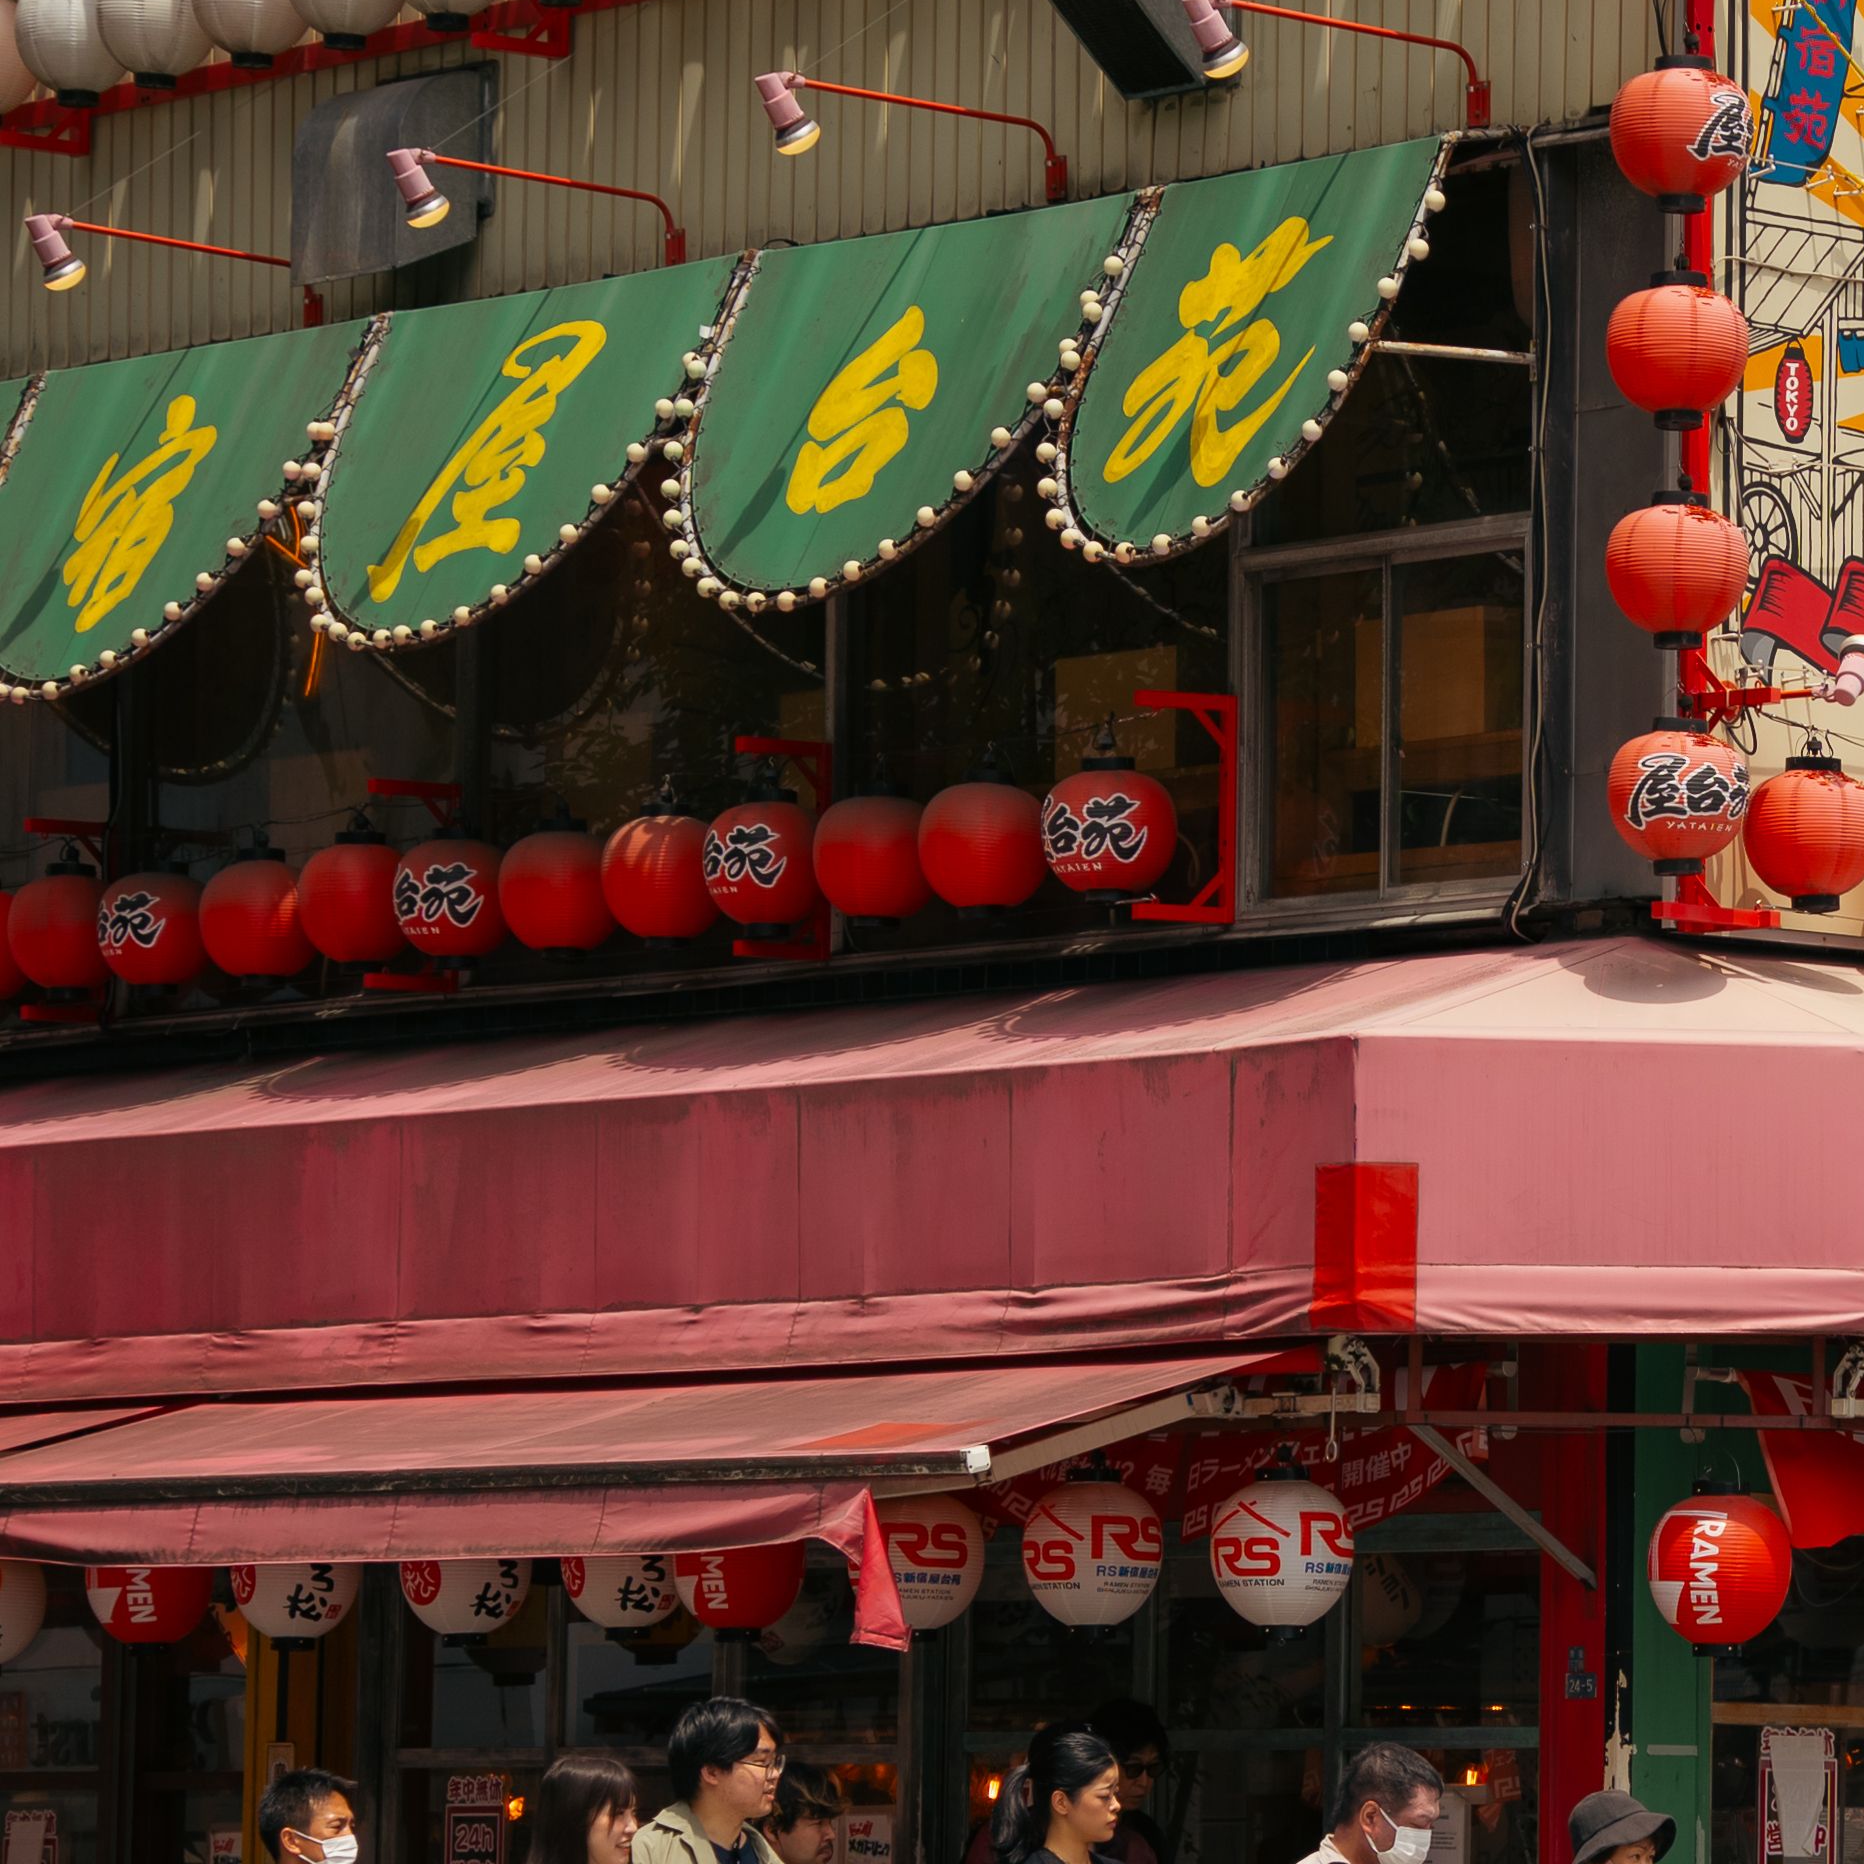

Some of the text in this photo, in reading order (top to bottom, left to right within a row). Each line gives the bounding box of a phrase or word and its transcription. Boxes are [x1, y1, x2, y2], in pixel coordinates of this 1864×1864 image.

[1686, 91, 1754, 161] 屋
[786, 306, 938, 514] 台
[1103, 216, 1334, 487] 苑
[1785, 362, 1799, 431] TOKYO
[1041, 793, 1148, 863] 台苑
[1667, 821, 1733, 833] YATAIEN
[1342, 1442, 1412, 1488] 開催中
[1091, 1515, 1161, 1561] RS
[1213, 1537, 1281, 1578] RS
[126, 1568, 157, 1623] MEN
[700, 1556, 729, 1609] MEN
[895, 1572, 961, 1585] S新宿屋台苑
[1242, 1579, 1284, 1588] STATION
[1689, 1519, 1727, 1626] RAMEN
[1569, 1678, 1593, 1693] 24-5
[448, 1776, 503, 1803] 年中無休
[455, 1824, 494, 1852] 24h
